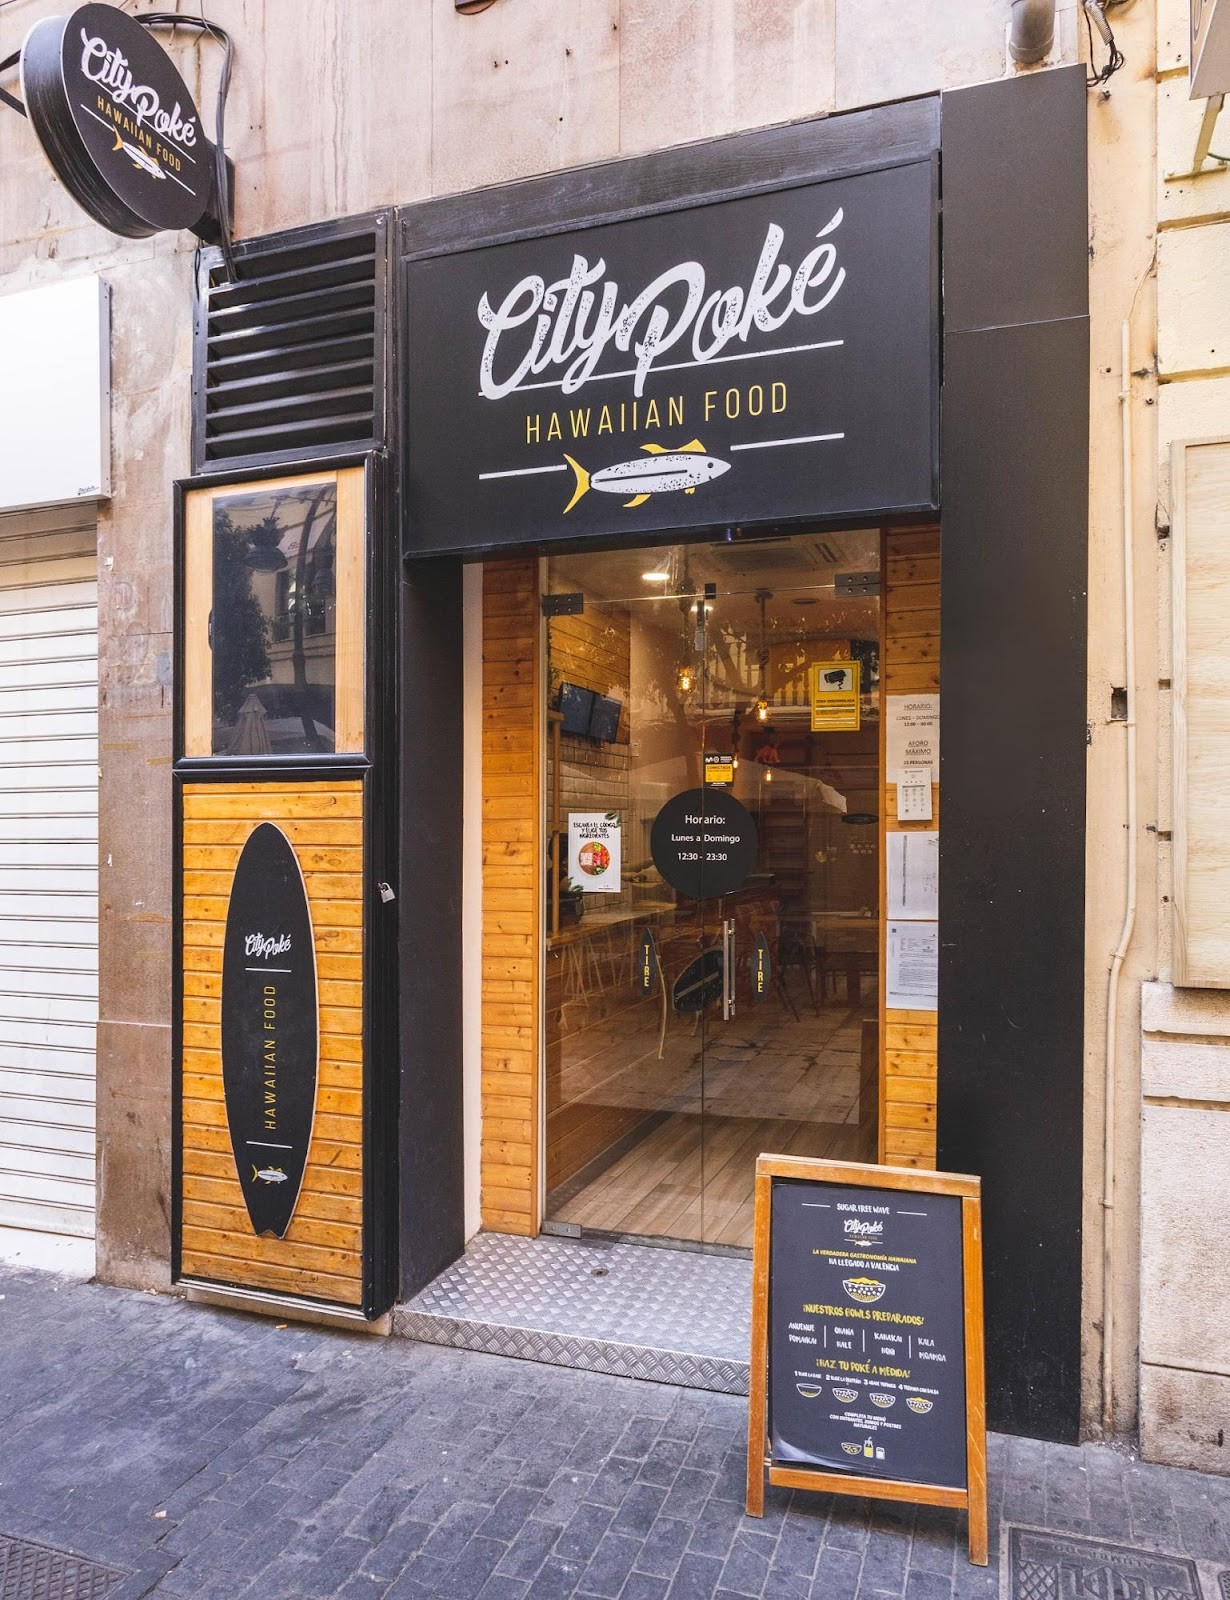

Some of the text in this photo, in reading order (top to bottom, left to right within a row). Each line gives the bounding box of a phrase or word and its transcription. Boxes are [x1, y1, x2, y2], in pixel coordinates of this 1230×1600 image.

[98, 95, 181, 172] HAWAIIAN FOOD
[526, 382, 788, 444] HAWAIIAN FOOD
[685, 814, 726, 824] Horario:
[671, 834, 694, 842] Lunes
[704, 834, 741, 844] Domingo
[677, 852, 698, 861] 12:30
[706, 853, 728, 861] 23:30
[264, 986, 276, 1130] HAWAIIAN FOOD
[837, 1203, 890, 1214] SUGAR FREE WAVE
[820, 1249, 849, 1257] VERDADERA
[850, 1252, 887, 1261] GASTRONOMÍA
[888, 1255, 917, 1264] HAWAIANA
[838, 1258, 864, 1268] LLEGADO
[865, 1261, 870, 1269] A
[870, 1262, 900, 1272] VALENCIA
[845, 1308, 871, 1319] BOWLS
[872, 1310, 924, 1326] PREPARADOS!
[917, 1337, 935, 1347] KALA
[838, 1361, 849, 1371] TU
[850, 1359, 870, 1373] POKÉ
[871, 1365, 878, 1374] A
[879, 1366, 912, 1378] MEDIDA!
